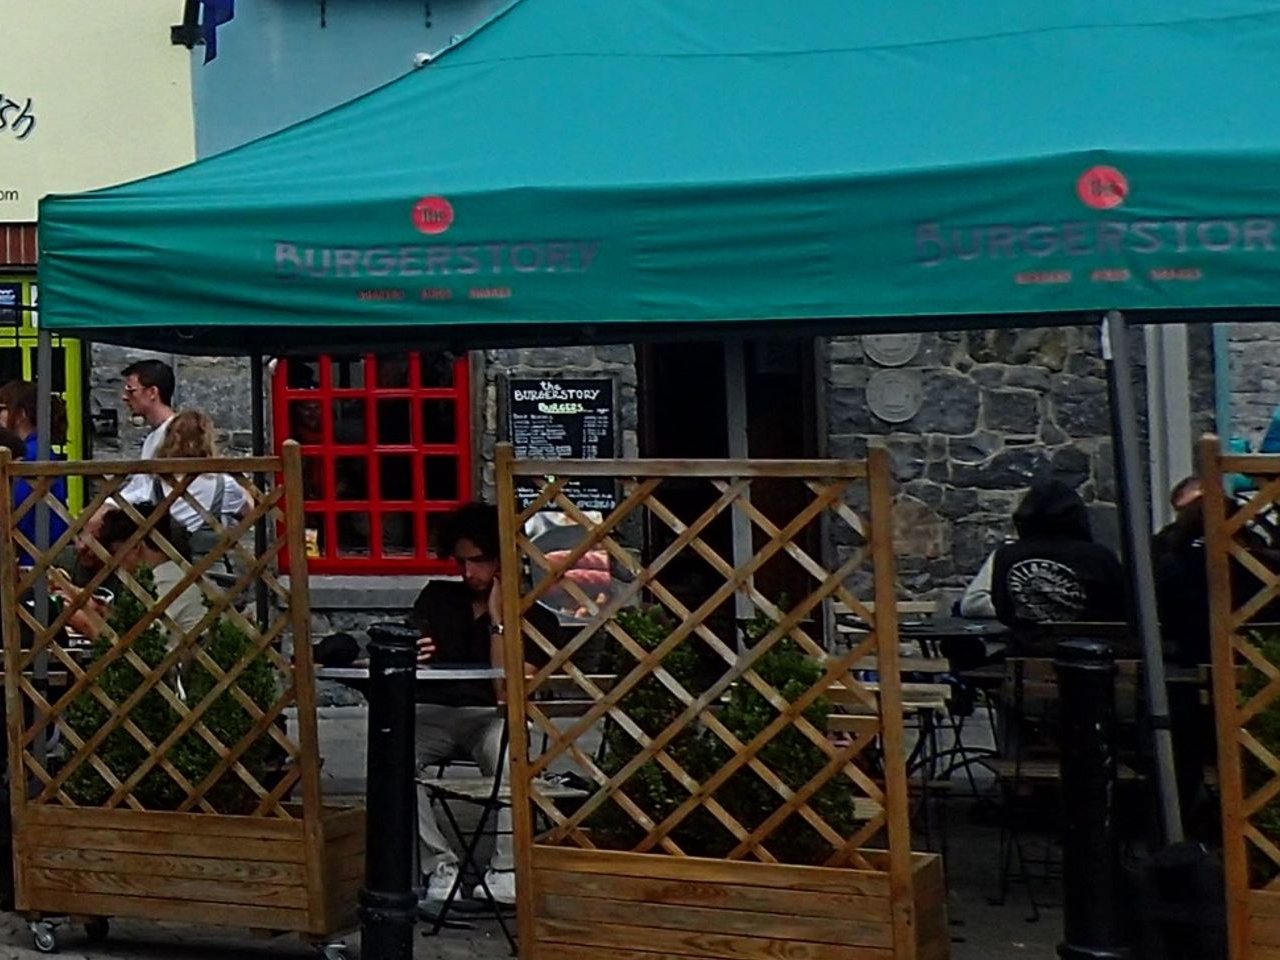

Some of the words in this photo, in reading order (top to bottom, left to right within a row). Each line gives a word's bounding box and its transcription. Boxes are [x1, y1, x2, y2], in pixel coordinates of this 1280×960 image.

[275, 241, 600, 280] BURGERSTORY
[915, 217, 1280, 268] BURGERSTOR
[514, 390, 600, 401] BURGERSTORY
